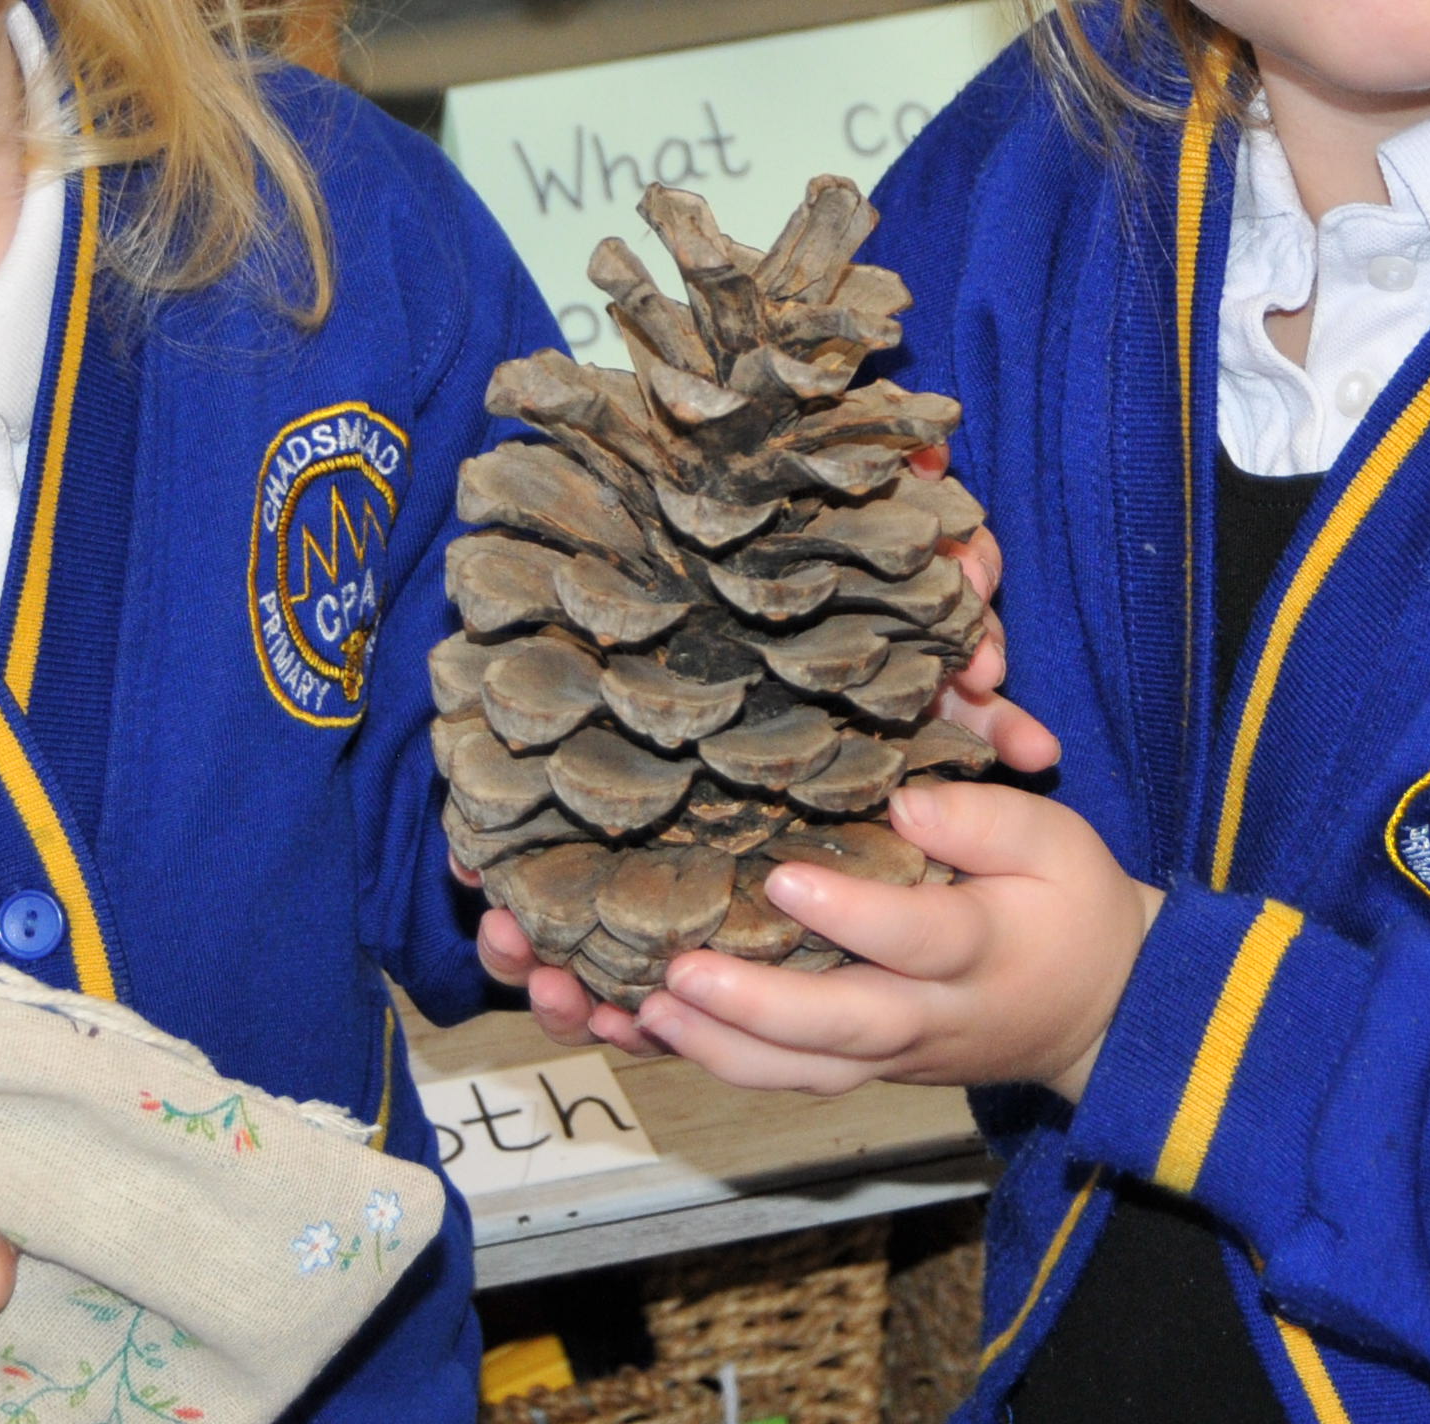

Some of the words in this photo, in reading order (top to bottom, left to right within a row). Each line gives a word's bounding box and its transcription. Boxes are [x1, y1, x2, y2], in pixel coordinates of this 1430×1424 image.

[511, 101, 752, 215] What
[259, 590, 332, 711] PRIMARY
[315, 568, 376, 643] CPA
